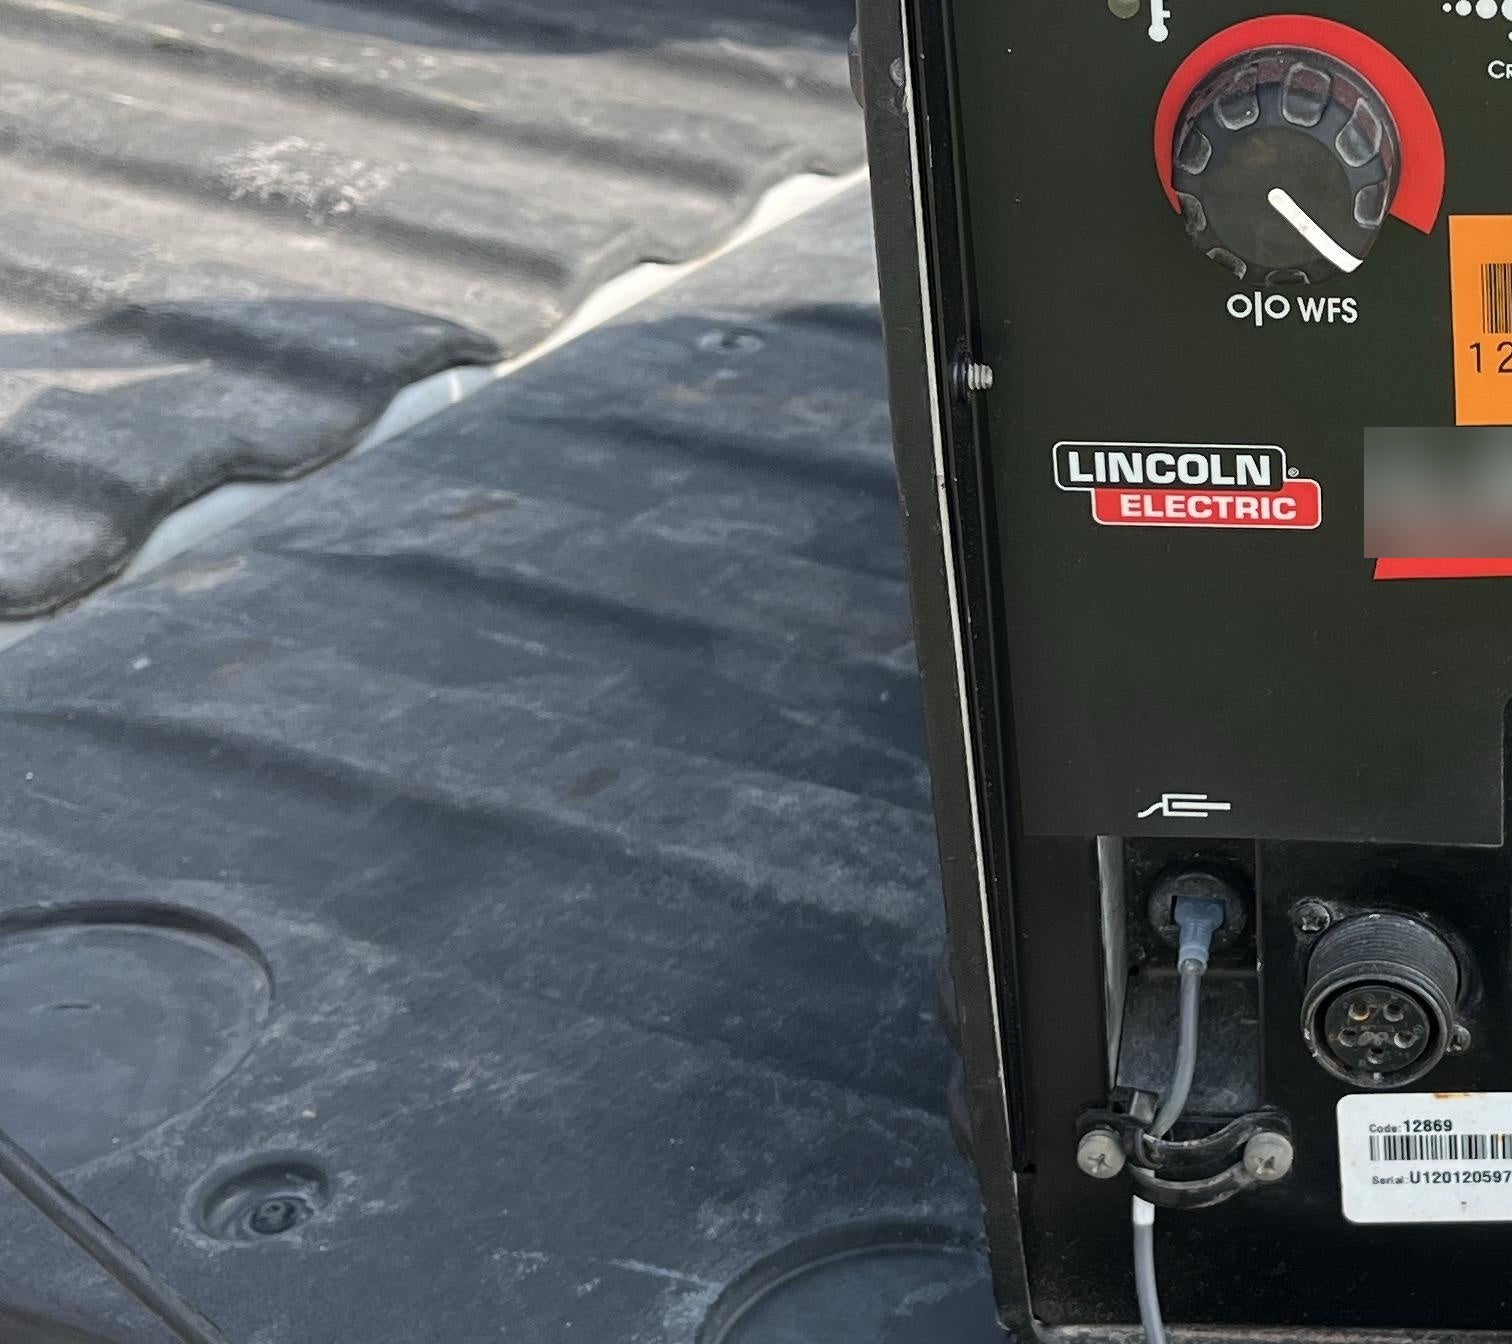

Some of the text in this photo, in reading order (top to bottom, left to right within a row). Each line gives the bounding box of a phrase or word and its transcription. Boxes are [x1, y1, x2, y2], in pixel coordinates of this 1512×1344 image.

[1297, 296, 1358, 324] WFS
[1068, 450, 1271, 486] LINCOLN
[1120, 494, 1297, 521] ELECTRIC
[1403, 1119, 1453, 1133] 12869
